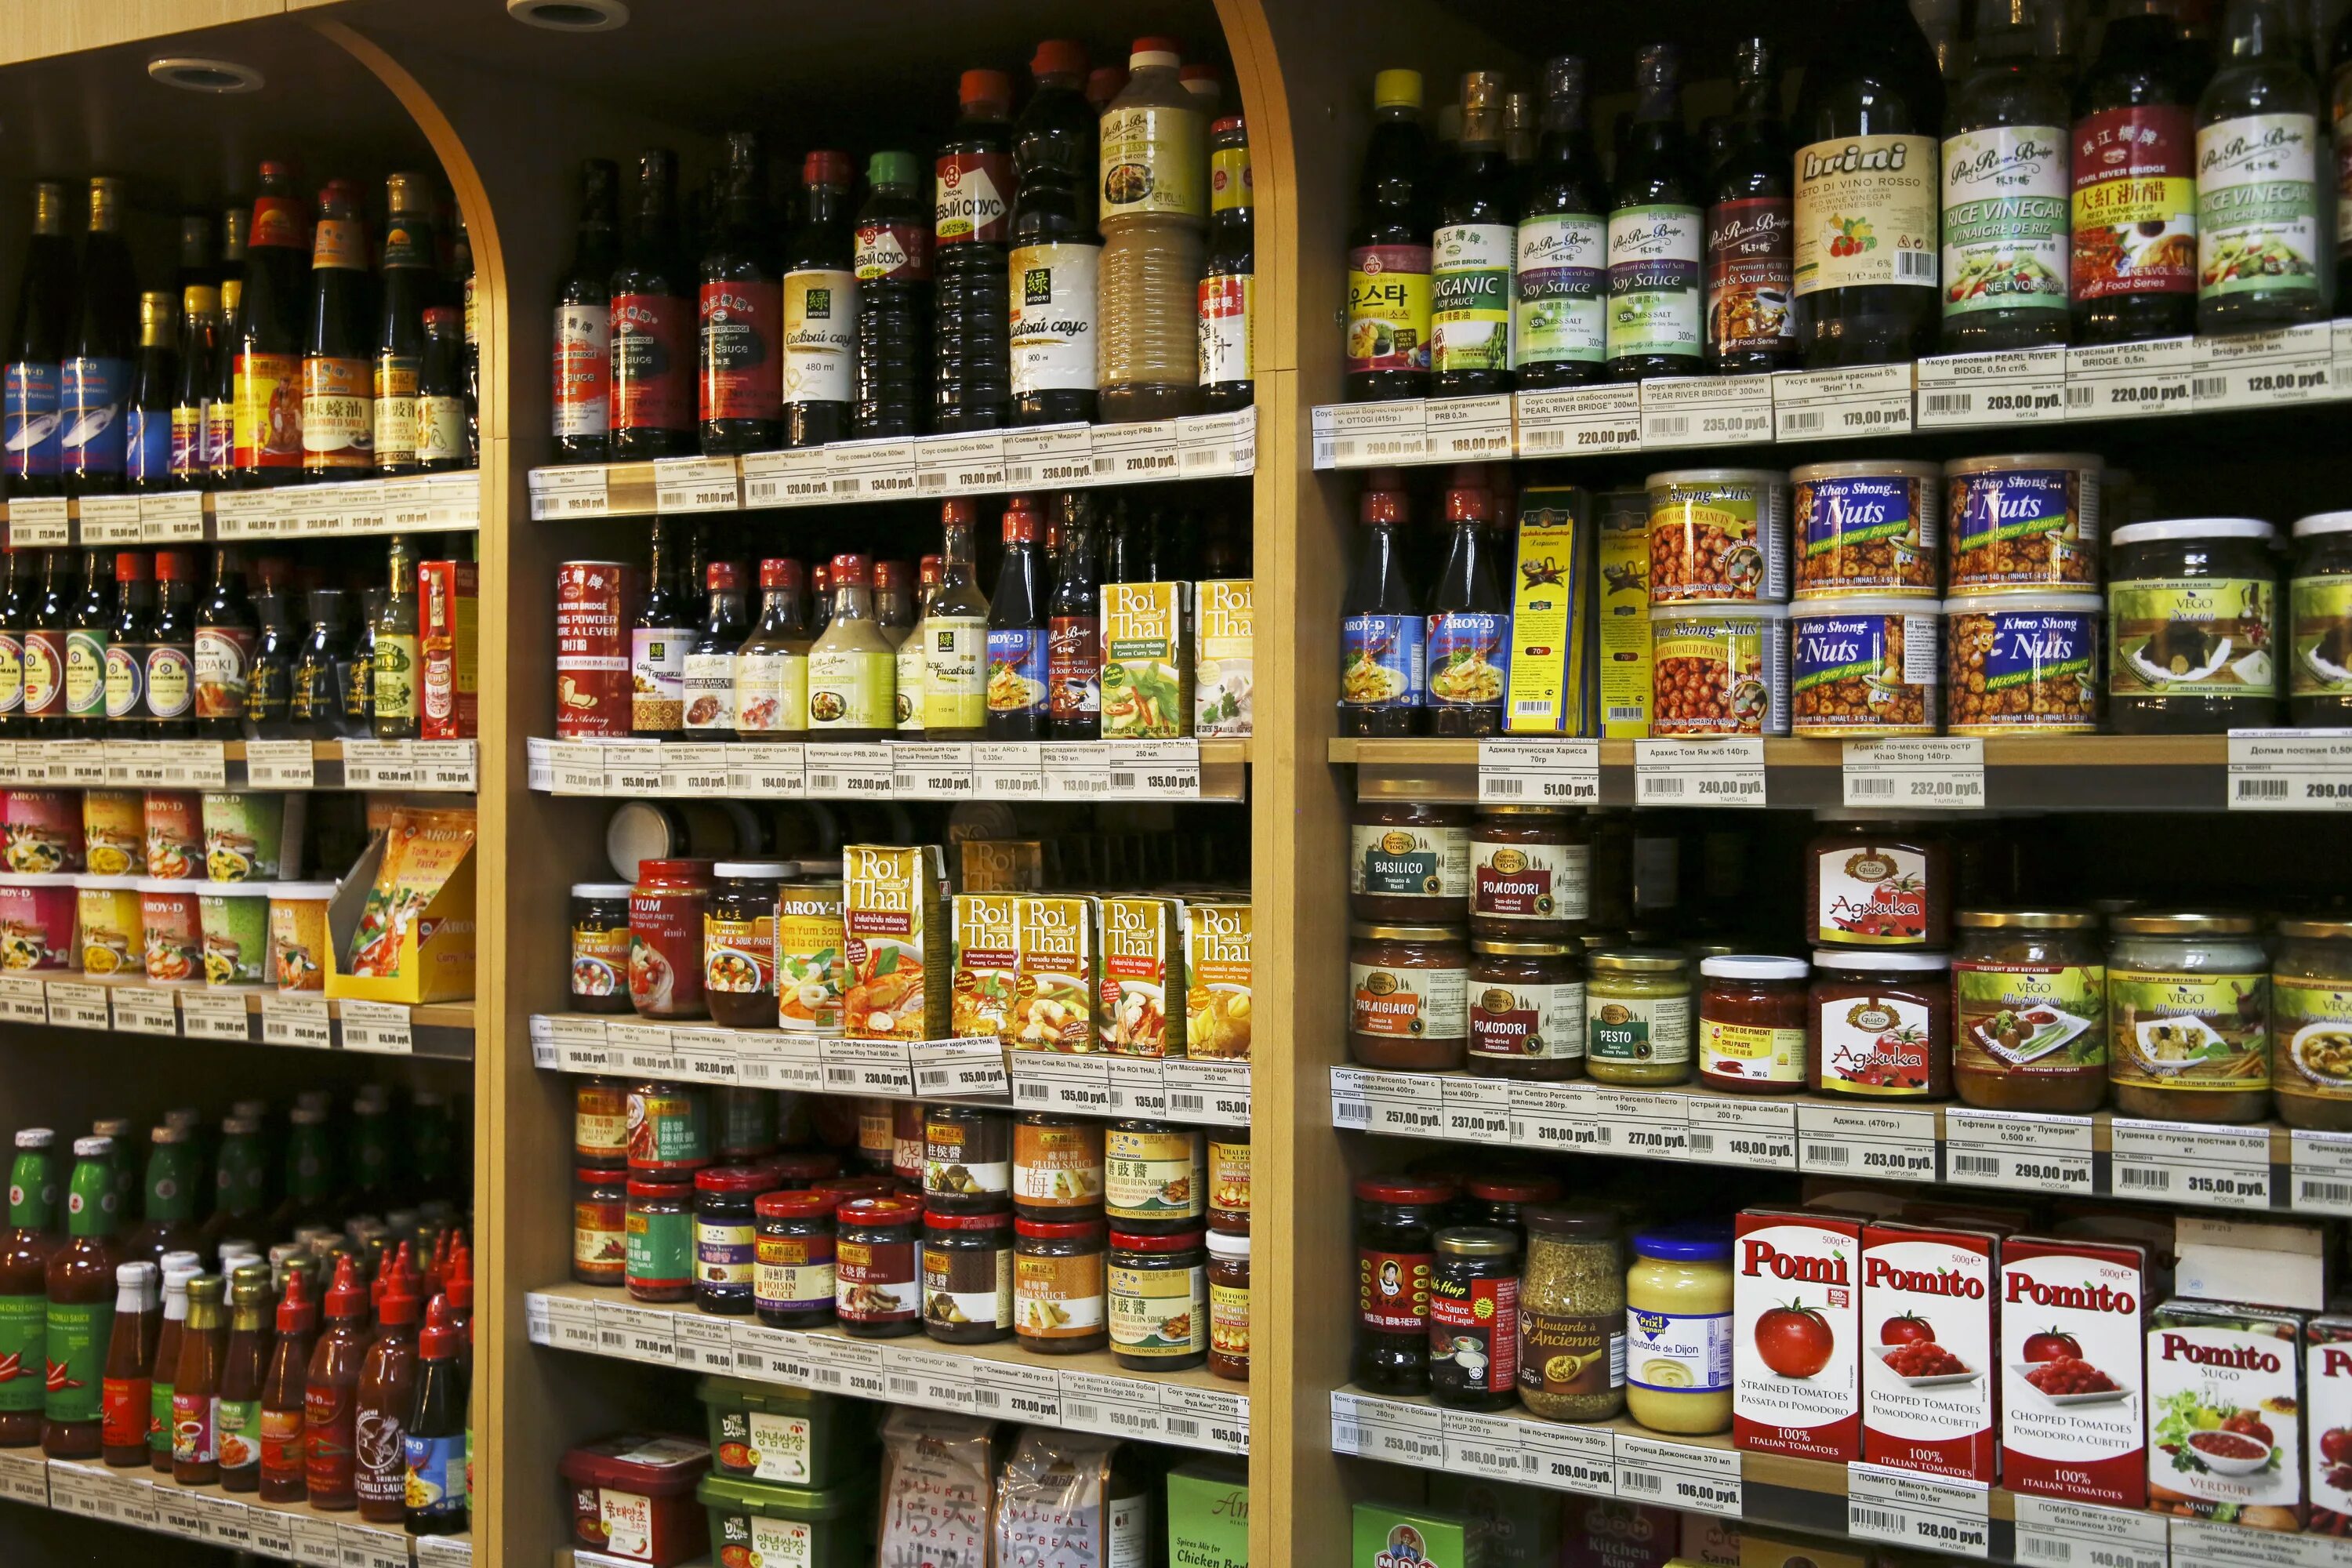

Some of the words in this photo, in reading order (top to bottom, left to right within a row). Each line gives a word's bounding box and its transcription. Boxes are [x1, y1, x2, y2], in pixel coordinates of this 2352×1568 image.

[1804, 143, 1907, 182] brini
[1840, 179, 1872, 187] VINO
[1878, 178, 1921, 187] ROSSO
[963, 200, 1000, 215] СОУС
[1947, 204, 1978, 228] RICE
[1983, 201, 2063, 220] VINEGAR
[1954, 223, 2007, 241] VINAIGRE
[2012, 223, 2028, 234] DE
[2031, 223, 2051, 235] RIZ
[1541, 237, 1564, 250] River
[1565, 232, 1592, 245] Bridge
[1523, 282, 1543, 296] Soy
[1547, 280, 1590, 293] Sauce
[1438, 299, 1448, 309] SOY
[1450, 297, 1474, 306] SAUCE
[1051, 320, 1088, 336] соус
[1530, 318, 1545, 327] 35%
[1811, 375, 1842, 383] винный
[1845, 372, 1882, 381] красный
[1545, 395, 1574, 404] соевый
[1576, 391, 1632, 401] слабосоленый
[1523, 405, 1551, 415] "PEARL
[1552, 404, 1576, 412] RIVER
[1578, 401, 1610, 412] BRIDGE"
[1613, 401, 1639, 409] 300мл.
[1578, 432, 1614, 445] 220,00
[1617, 430, 1639, 442] руб.
[1042, 466, 1071, 479] 236,00
[1075, 465, 1091, 477] руб.
[1820, 485, 1847, 496] Khao
[1853, 483, 1890, 495] Shong
[1824, 498, 1886, 525] Nuts
[1842, 531, 1869, 543] SPICY
[1871, 521, 1907, 537] PEANUTS
[1116, 587, 1156, 611] Roi
[572, 615, 616, 625] POWDER
[1112, 612, 1167, 638] Thai
[1444, 618, 1494, 631] AROY-D
[2011, 633, 2073, 659] Nuts
[1987, 672, 2030, 690] MEXICAN
[1488, 746, 1515, 756] Аджика
[1650, 748, 1677, 758] Арахис
[1679, 748, 1695, 757] Том
[1697, 748, 1708, 757] Ям
[1710, 748, 1725, 757] ж/б
[1726, 748, 1750, 757] 140гр.
[848, 779, 873, 789] 229,00
[875, 780, 891, 791] руб.
[1544, 784, 1571, 797] 51,00
[1574, 784, 1596, 797] руб.
[411, 847, 429, 857] Tom
[435, 849, 452, 858] Yum
[416, 859, 439, 869] Paste
[859, 851, 901, 880] Roi
[1375, 861, 1422, 874] BASILICO
[851, 880, 909, 909] Thai
[1483, 880, 1538, 895] POMODORI
[636, 900, 661, 911] YUM
[735, 936, 751, 946] SOUR
[753, 937, 772, 946] PASTE
[2016, 983, 2051, 993] VEGO
[1356, 999, 1414, 1014] PARMIGIANO
[1600, 1030, 1632, 1044] PESTO
[1832, 1045, 1922, 1066] Аджика
[1028, 1058, 1042, 1067] Канг
[1067, 1062, 1081, 1070] Thai,
[1060, 1090, 1087, 1101] 135,00
[1090, 1093, 1108, 1104] руб.
[1833, 1117, 1867, 1126] Аджика.
[1868, 1119, 1900, 1129] (470гр.)
[1957, 1120, 1995, 1131] Тефтели
[2005, 1125, 2031, 1134] соусе
[2033, 1125, 2078, 1136] "Лукерия"
[1033, 1160, 1060, 1169] PLUM
[1127, 1178, 1145, 1186] BEAN
[764, 1280, 796, 1290] HOISIN
[1441, 1281, 1466, 1297] Hup
[766, 1290, 793, 1299] SAUCE
[1443, 1303, 1468, 1315] Sauce
[1534, 1318, 1585, 1334] Moutarde
[1589, 1322, 1596, 1331] à
[1630, 1337, 1661, 1352] Moutarde
[1675, 1345, 1699, 1356] Dijon
[2201, 1367, 2240, 1381] SUGO
[1087, 1384, 1102, 1392] River
[1103, 1386, 1123, 1396] Bridge
[1740, 1378, 1790, 1396] STRAINED
[1792, 1385, 1848, 1401] TOMATOES
[1741, 1395, 1776, 1406] PASSATA
[1778, 1399, 1788, 1408] DI
[1791, 1400, 1849, 1416] POMODORO
[1778, 1428, 1810, 1441] 100%
[1624, 1443, 1656, 1454] Горчица
[1658, 1449, 1701, 1461] Дижонская
[1704, 1454, 1718, 1463] 370
[1749, 1436, 1785, 1448] ITALIAN
[1788, 1442, 1838, 1456] TOMATOES
[1677, 1483, 1712, 1500] 106,00
[1715, 1488, 1740, 1504] руб.
[1859, 1473, 1896, 1485] ПОМИТО
[1899, 1480, 1930, 1492] Мякоть
[1933, 1487, 1976, 1499] помидора
[1009, 1508, 1088, 1527] NATURAL
[1003, 1531, 1088, 1550] SOYBEAN
[1177, 1537, 1196, 1548] Spices
[1198, 1541, 1210, 1551] Mix
[1211, 1544, 1221, 1553] for
[1588, 1538, 1651, 1560] Kitchen
[1177, 1549, 1220, 1568] Chicken
